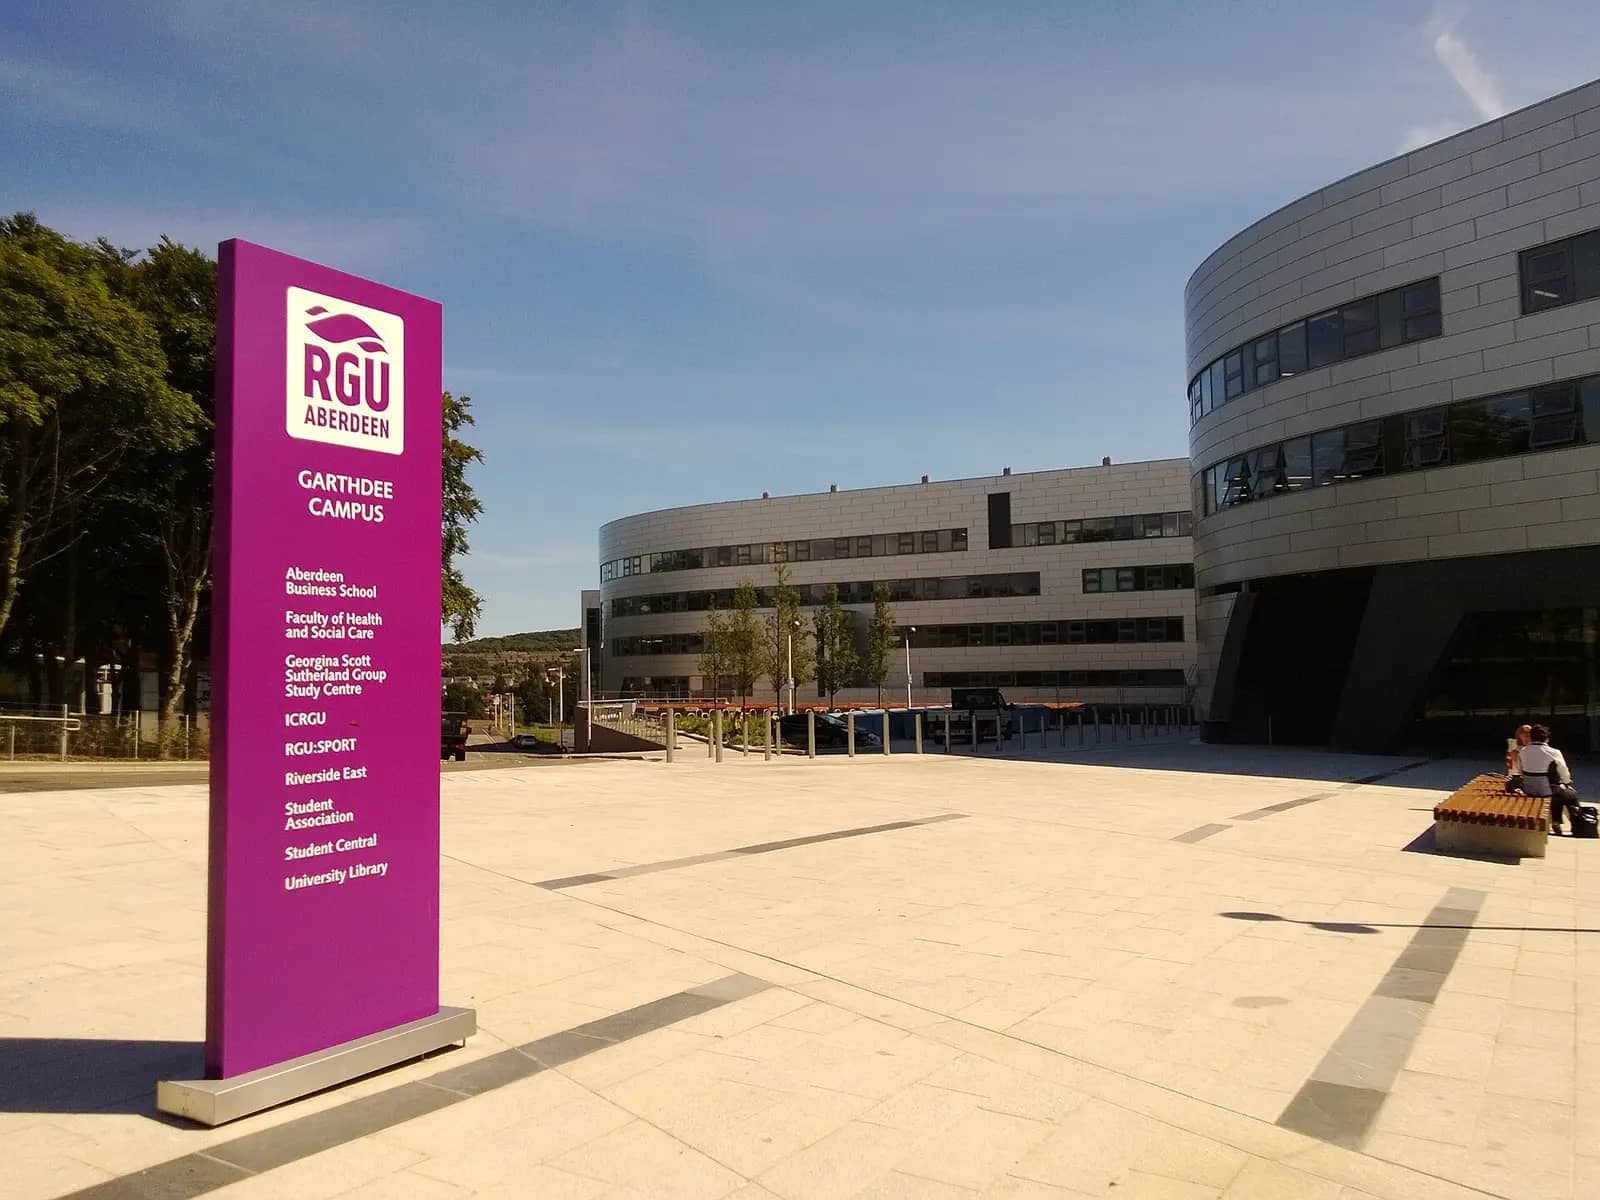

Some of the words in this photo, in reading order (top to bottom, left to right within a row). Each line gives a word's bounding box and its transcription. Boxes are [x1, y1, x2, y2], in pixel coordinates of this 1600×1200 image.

[304, 342, 390, 412] RGU
[304, 404, 389, 439] ABERDEEN
[298, 470, 393, 499] GARTHDEE
[309, 498, 384, 522] CAMPUS
[286, 567, 343, 582] Aberdeen
[286, 582, 337, 596] Business
[339, 584, 376, 598] School
[286, 611, 328, 628] Faculty
[331, 612, 344, 625] of
[346, 612, 382, 625] Health
[285, 626, 308, 639] and
[311, 626, 345, 639] Social
[348, 627, 374, 640] Care
[285, 654, 339, 671] Georgina
[341, 655, 371, 667] Scott
[285, 669, 349, 682] Sutherland
[352, 668, 386, 683] Group
[285, 683, 320, 699] Study
[323, 683, 362, 695] Centre
[285, 712, 326, 727] ICRGU
[285, 738, 357, 756] RGU:SPORT
[285, 768, 340, 785] Riverside
[343, 766, 367, 779] East
[285, 798, 333, 815] Student
[285, 811, 354, 830] Association
[285, 841, 333, 860] Student
[336, 834, 377, 851] Central
[285, 869, 347, 890] University
[349, 862, 388, 878] Library
